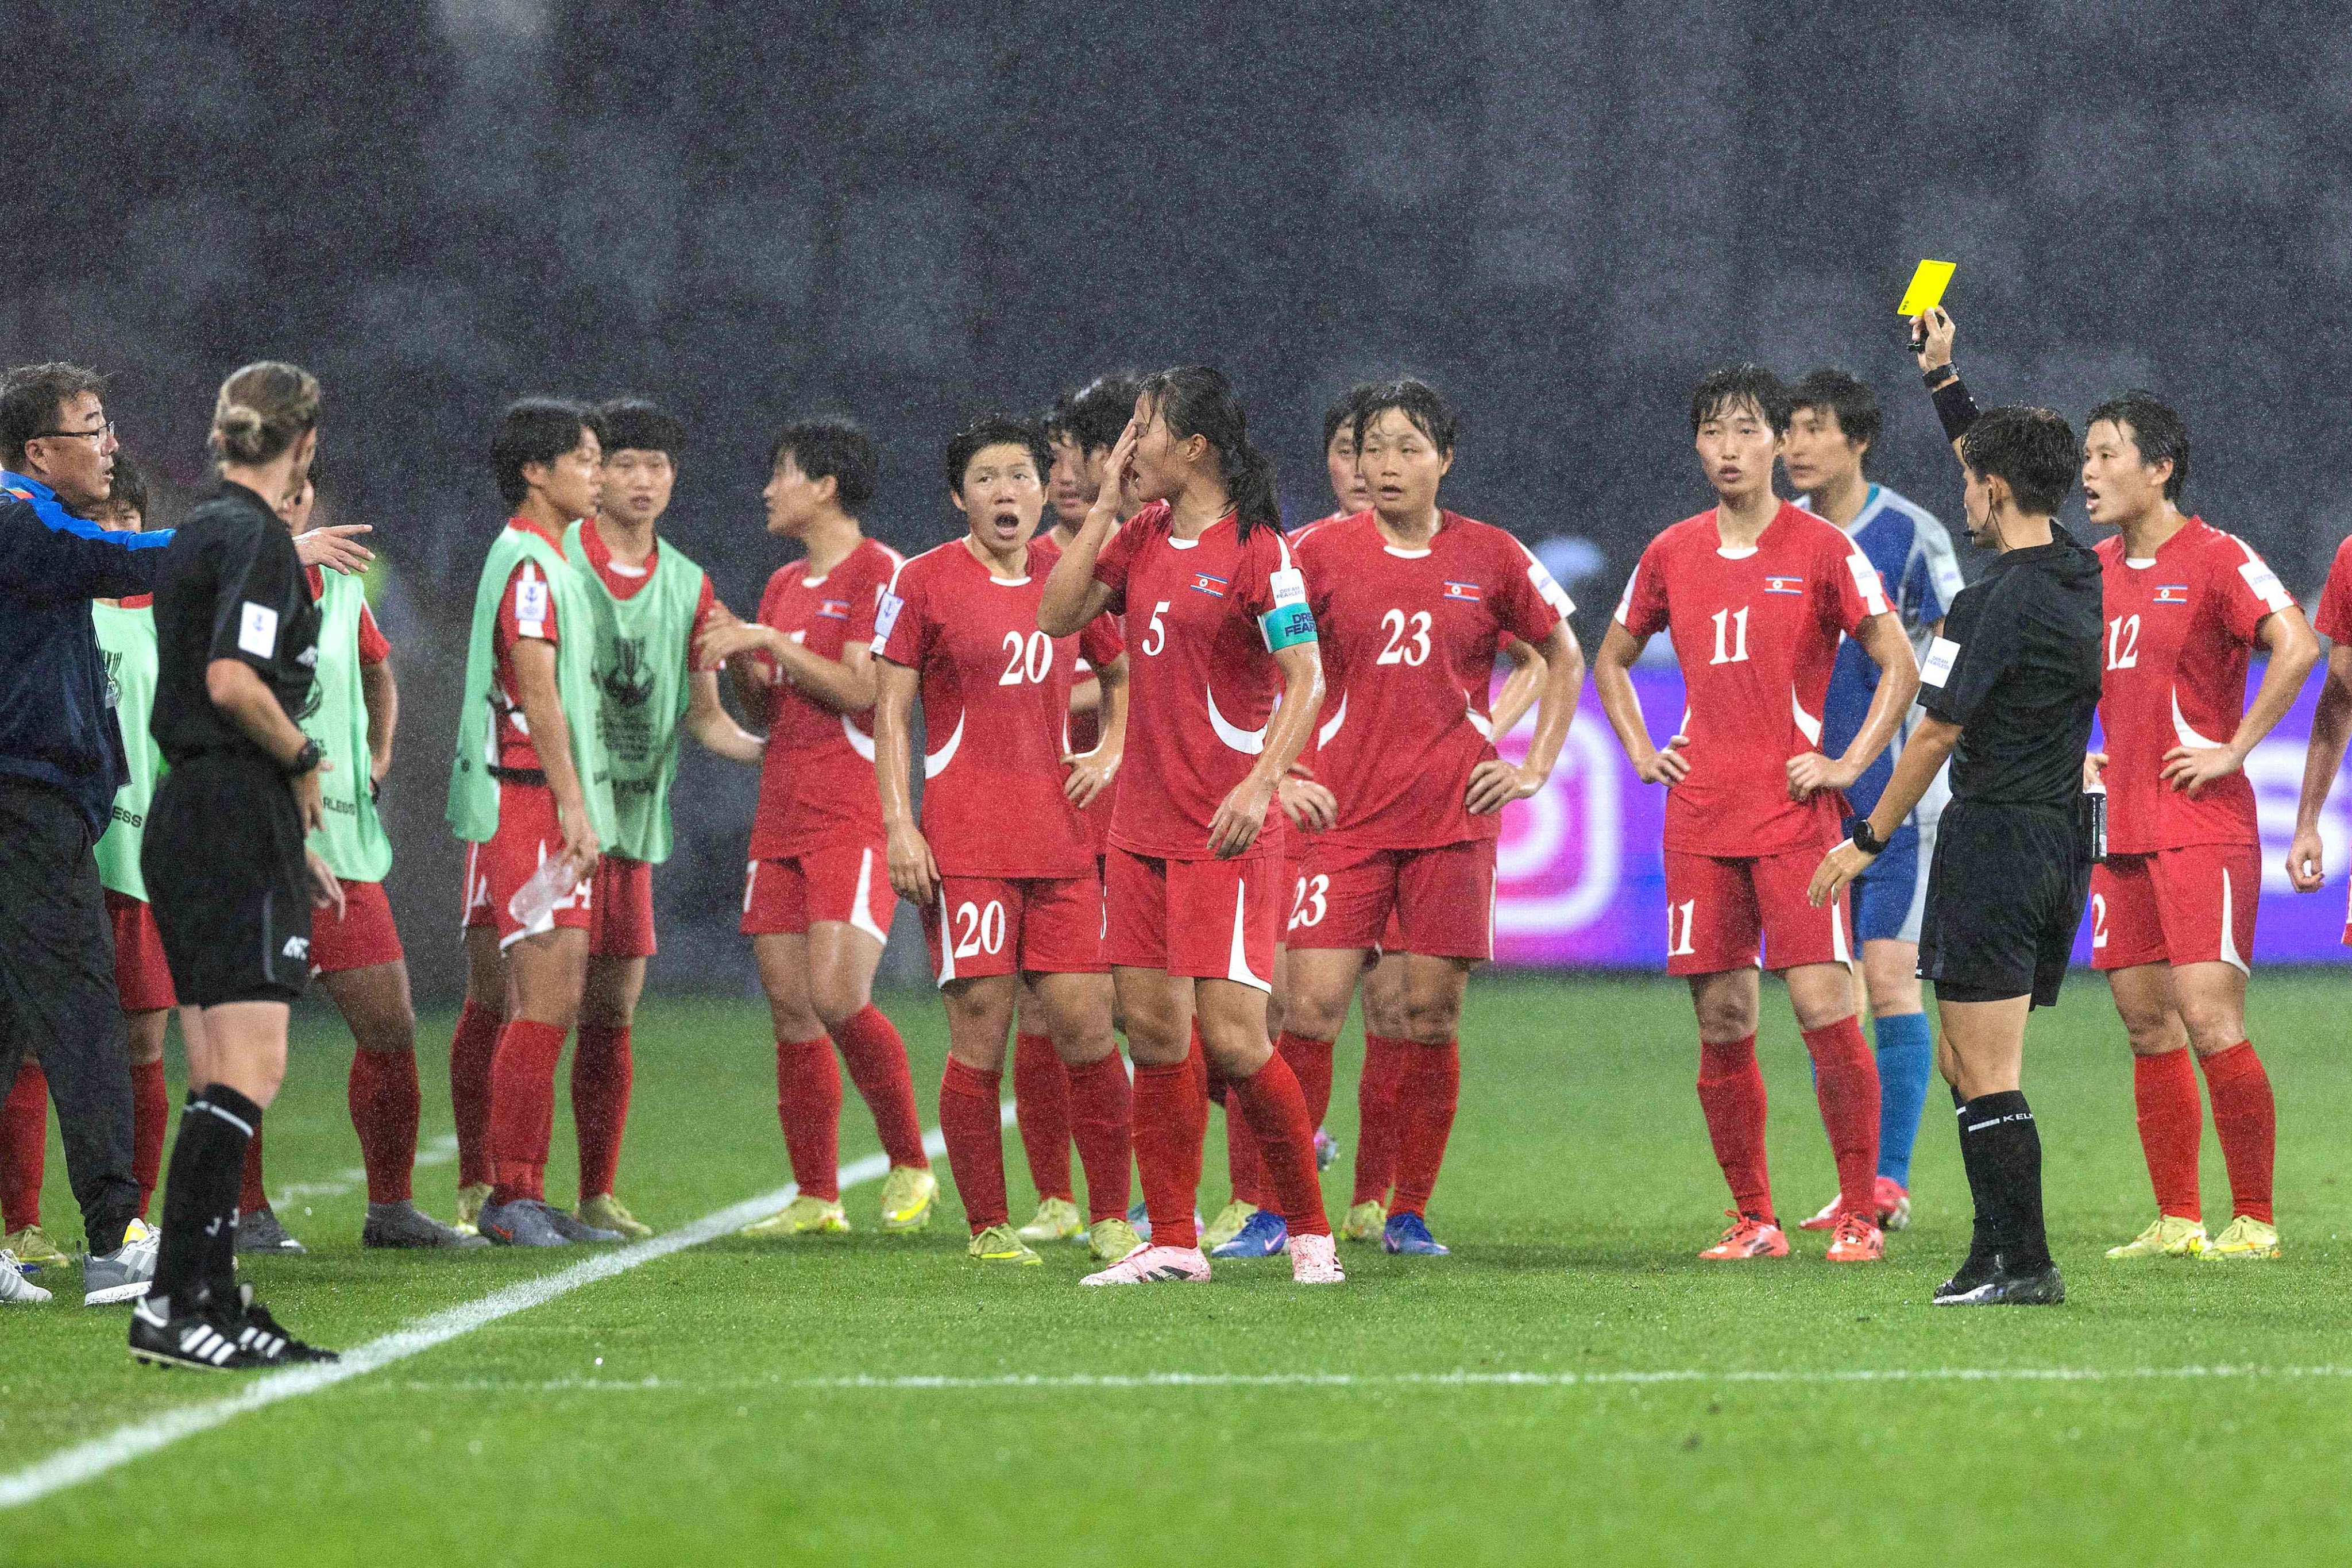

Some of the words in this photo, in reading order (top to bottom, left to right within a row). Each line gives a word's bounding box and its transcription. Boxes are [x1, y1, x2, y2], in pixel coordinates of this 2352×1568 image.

[1142, 601, 1171, 656] 5
[1376, 609, 1432, 666] 23
[1709, 605, 1749, 665] 11
[2106, 613, 2141, 671] 12
[998, 630, 1053, 686] 20
[954, 900, 1006, 959] 20
[1287, 874, 1330, 931] 23
[1667, 899, 1695, 956] 11
